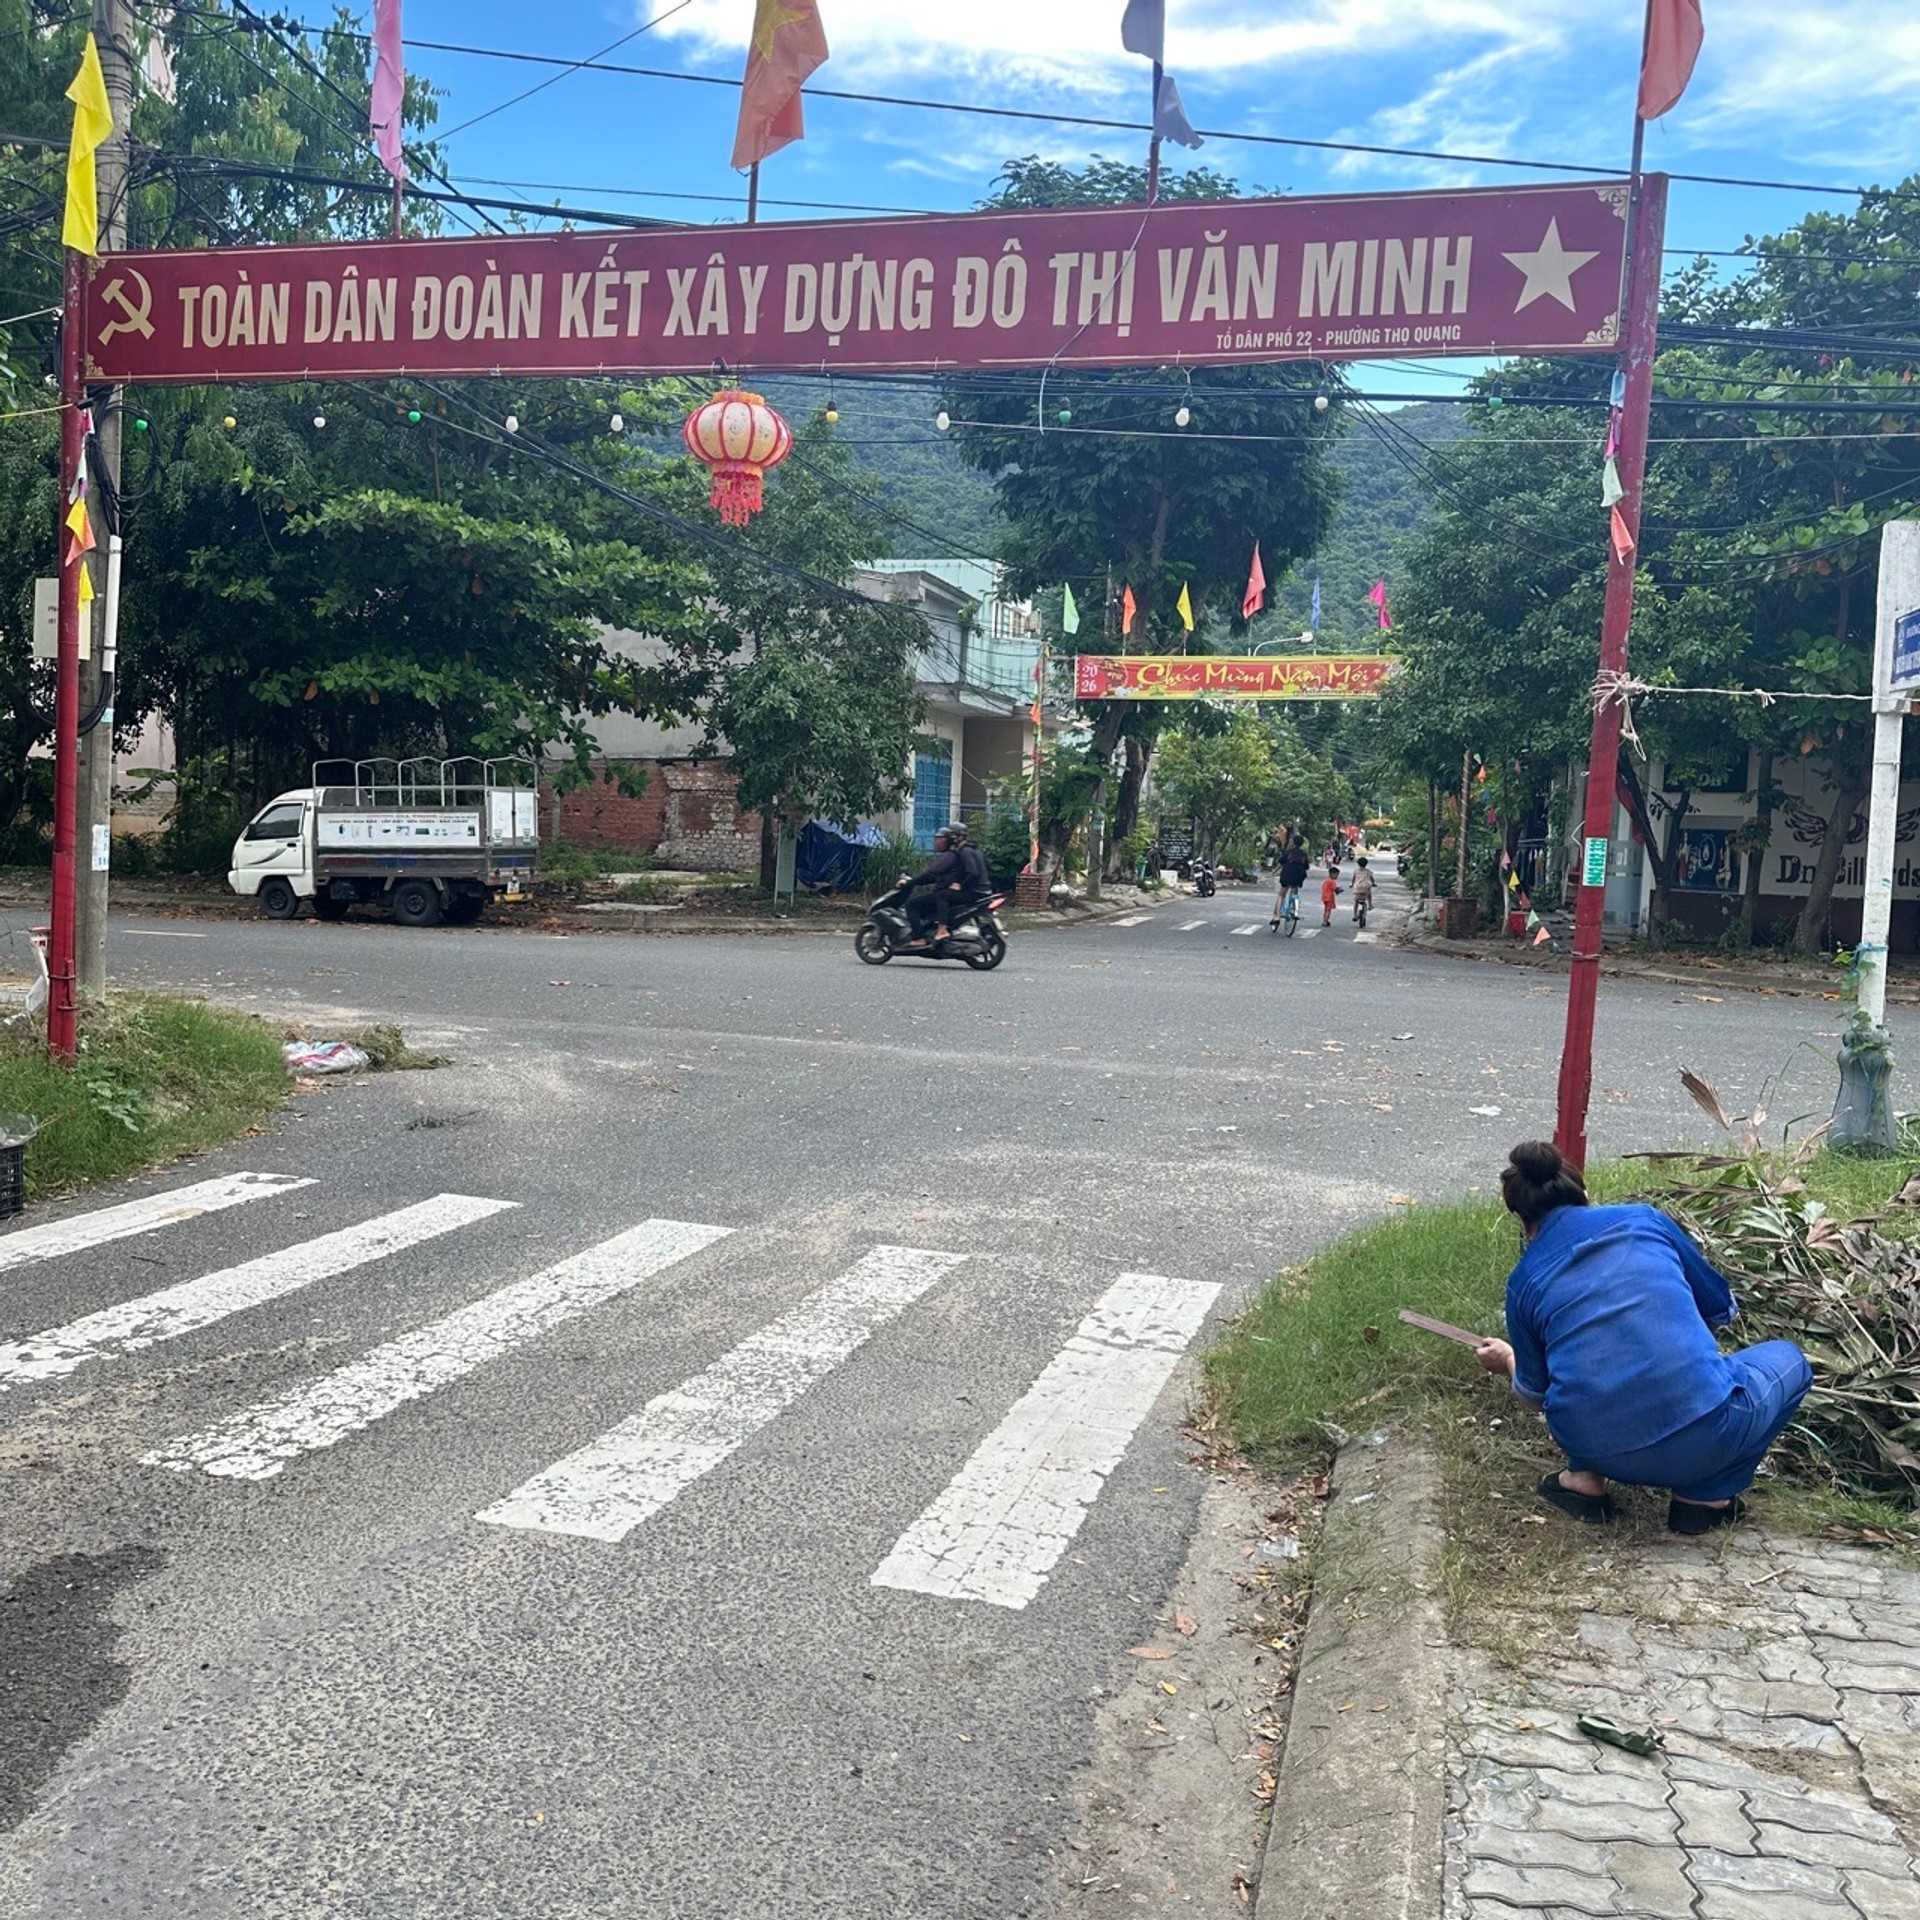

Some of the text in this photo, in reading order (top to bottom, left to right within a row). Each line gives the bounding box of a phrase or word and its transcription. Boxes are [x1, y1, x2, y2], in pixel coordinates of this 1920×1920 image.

[179, 229, 1473, 348] TOÀN DÂN ĐOÀN KẾT XÂY DỰNG ĐÔ THỊ VĂN MINH
[1216, 326, 1232, 349] TỔ
[1235, 329, 1263, 349] DÂN
[1266, 325, 1293, 347] PHỐ
[1296, 331, 1313, 346] 22
[1325, 324, 1381, 346] PHƯỜNG
[1384, 327, 1410, 346] THỌ
[1414, 325, 1461, 343] QUANG
[1081, 664, 1098, 678] 20
[1137, 660, 1202, 687] Chúc
[1205, 663, 1264, 697] Mừng
[1270, 663, 1322, 685] Năm
[1328, 662, 1370, 684] Mới
[1080, 680, 1098, 693] 26
